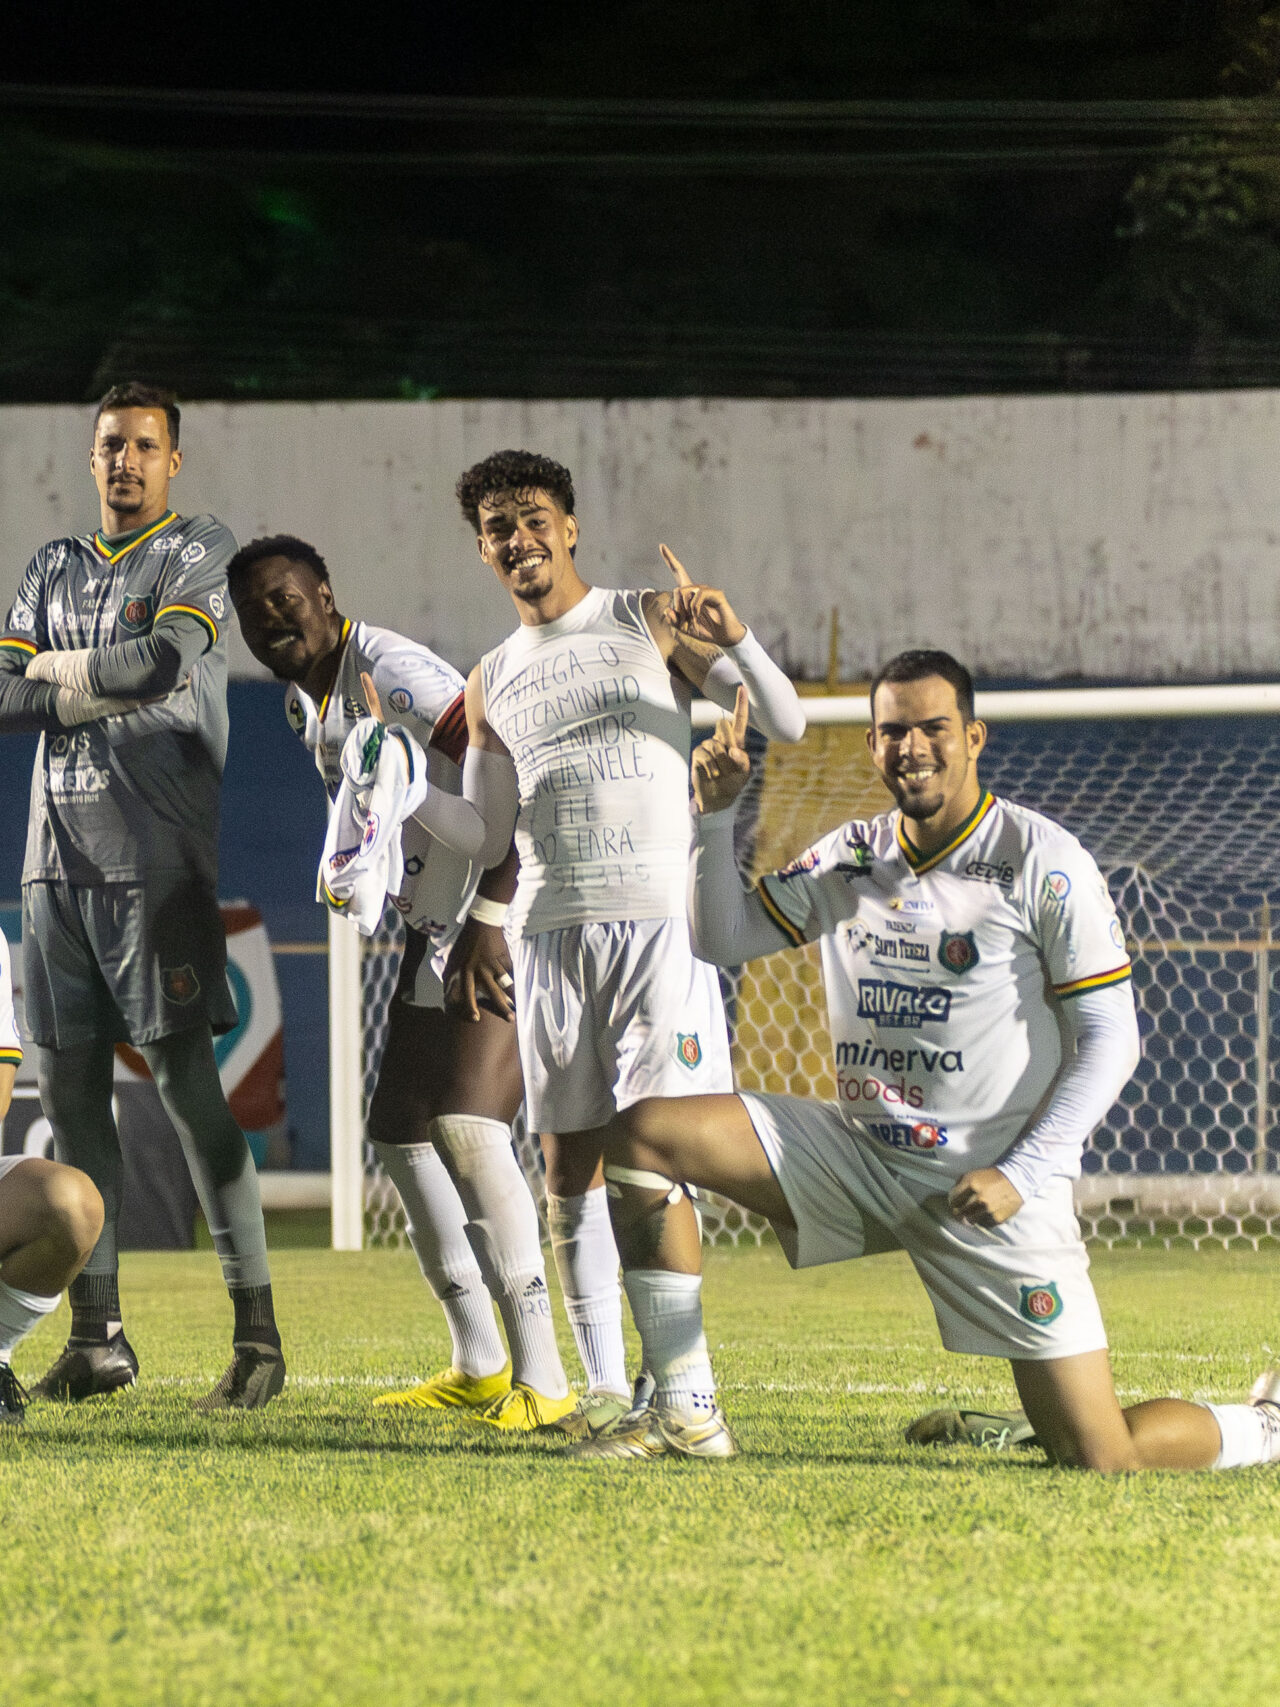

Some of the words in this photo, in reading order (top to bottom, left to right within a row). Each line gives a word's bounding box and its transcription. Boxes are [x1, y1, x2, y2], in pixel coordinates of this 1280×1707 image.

[598, 641, 619, 668] O
[835, 1038, 964, 1073] minerva
[836, 1069, 924, 1108] foods
